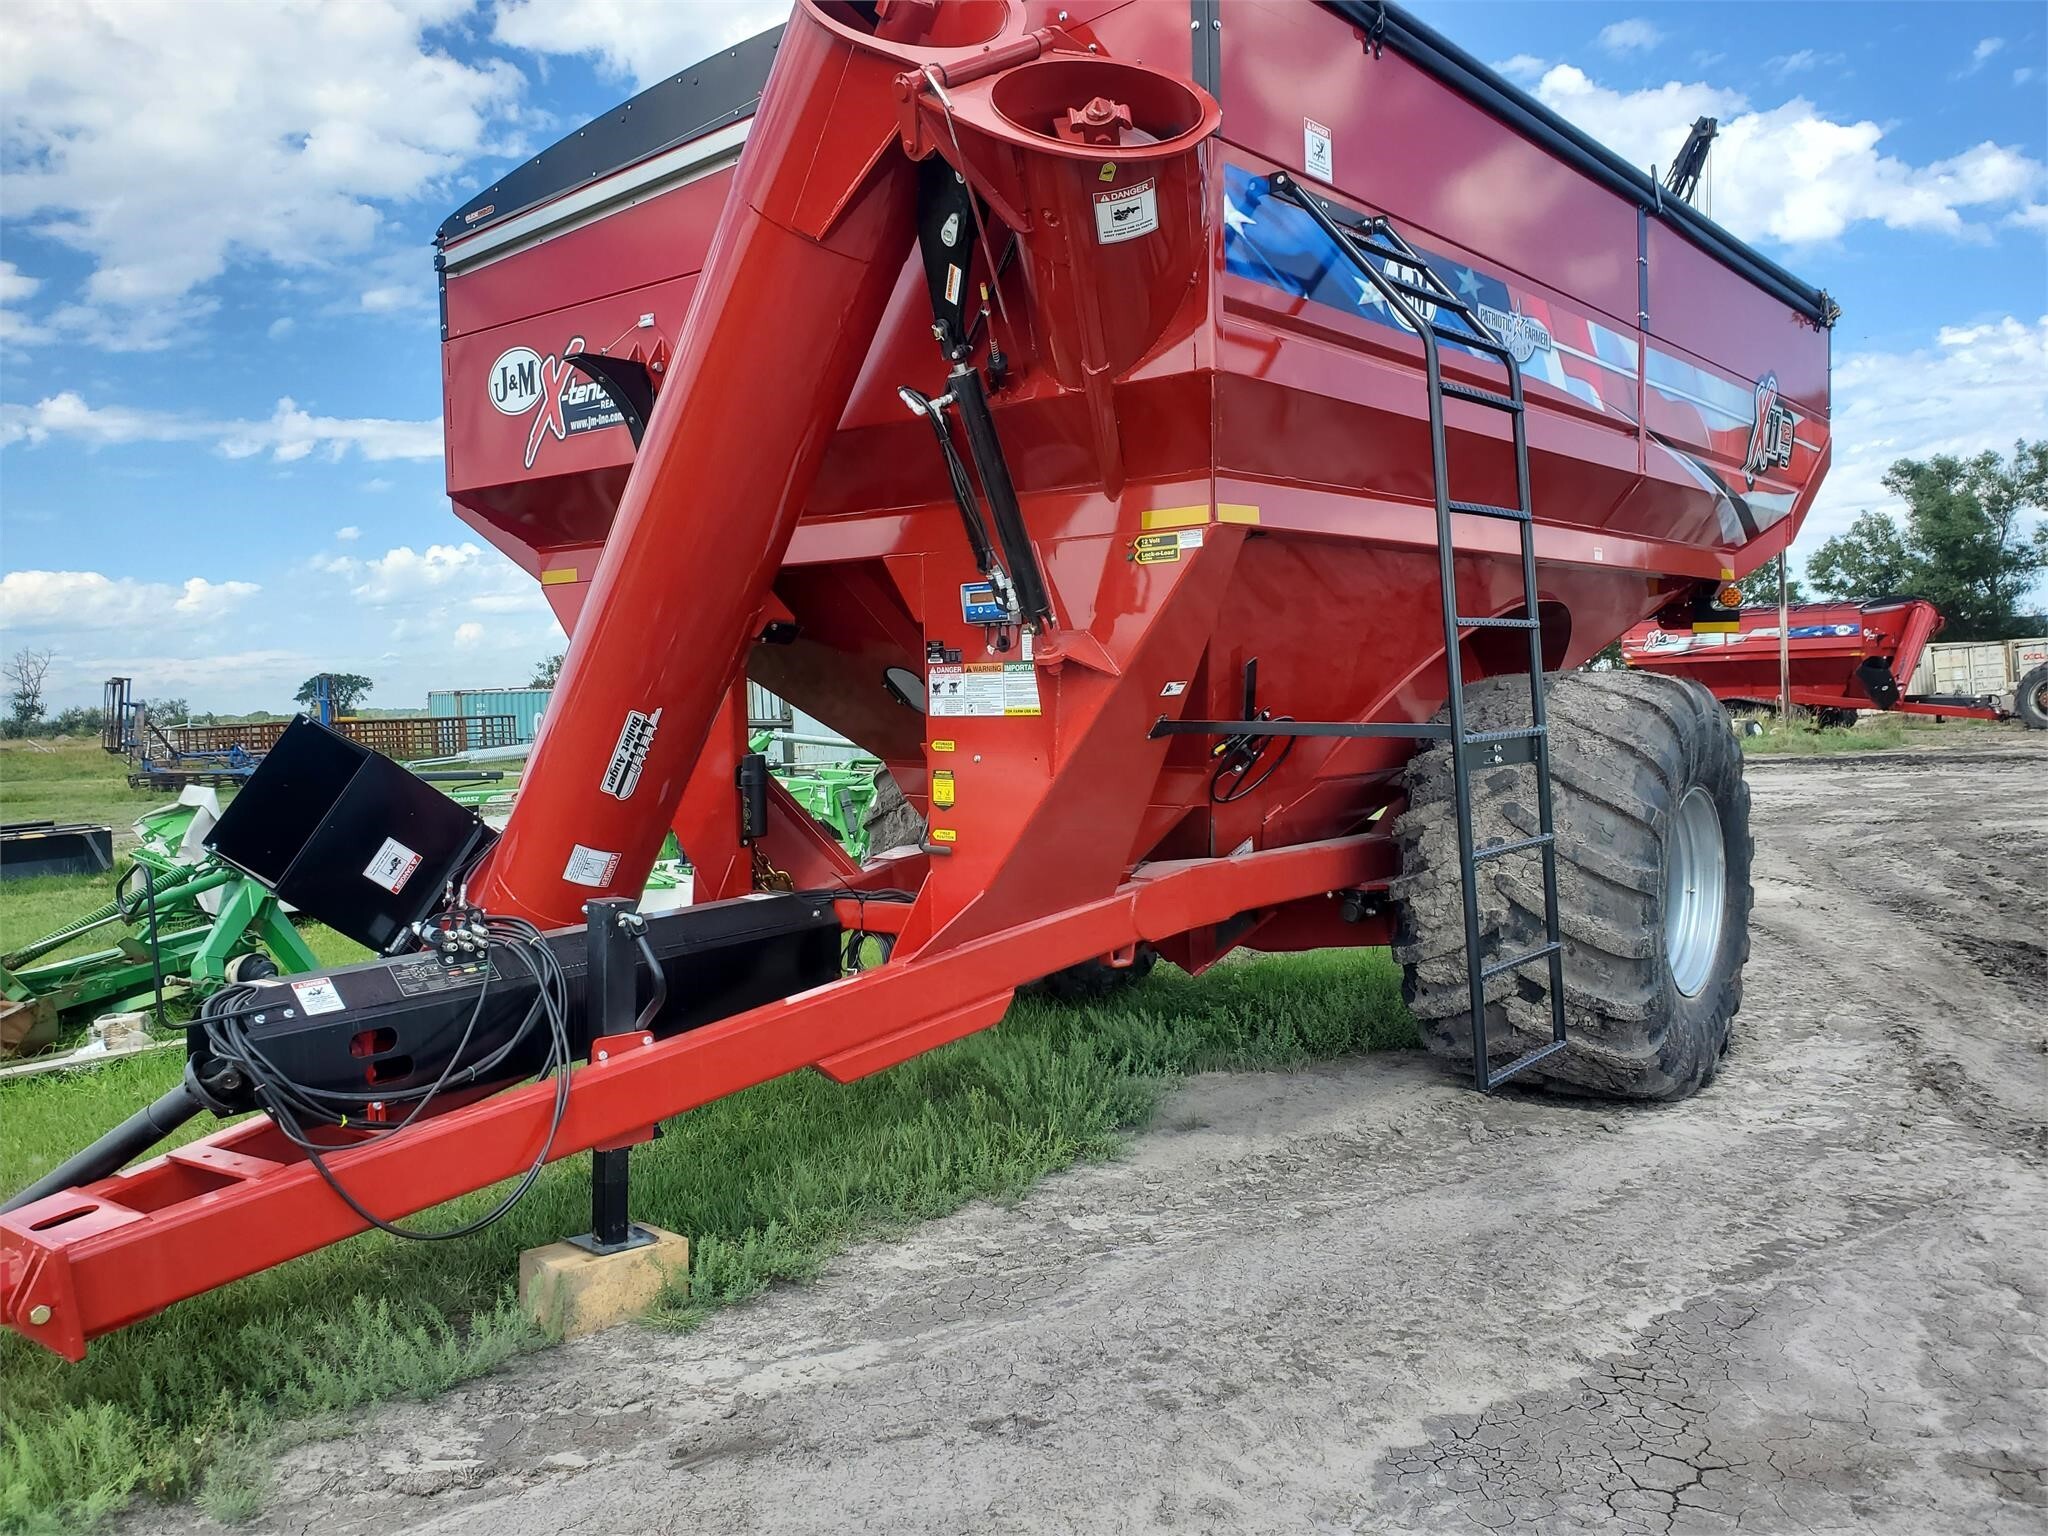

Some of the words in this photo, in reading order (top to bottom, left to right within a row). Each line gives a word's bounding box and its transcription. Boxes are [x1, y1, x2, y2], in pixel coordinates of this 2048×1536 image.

[1110, 183, 1149, 200] DANGER
[1480, 308, 1512, 332] PATRIOTIC
[1524, 325, 1549, 347] FARMER
[494, 360, 537, 403] J&M
[600, 399, 617, 410] REA
[936, 666, 962, 674] DANGER
[972, 665, 1002, 673] WARNING
[621, 715, 641, 752] Bullet
[607, 754, 625, 790] Auger
[394, 864, 414, 890] DANGER
[601, 860, 616, 886] DANGER
